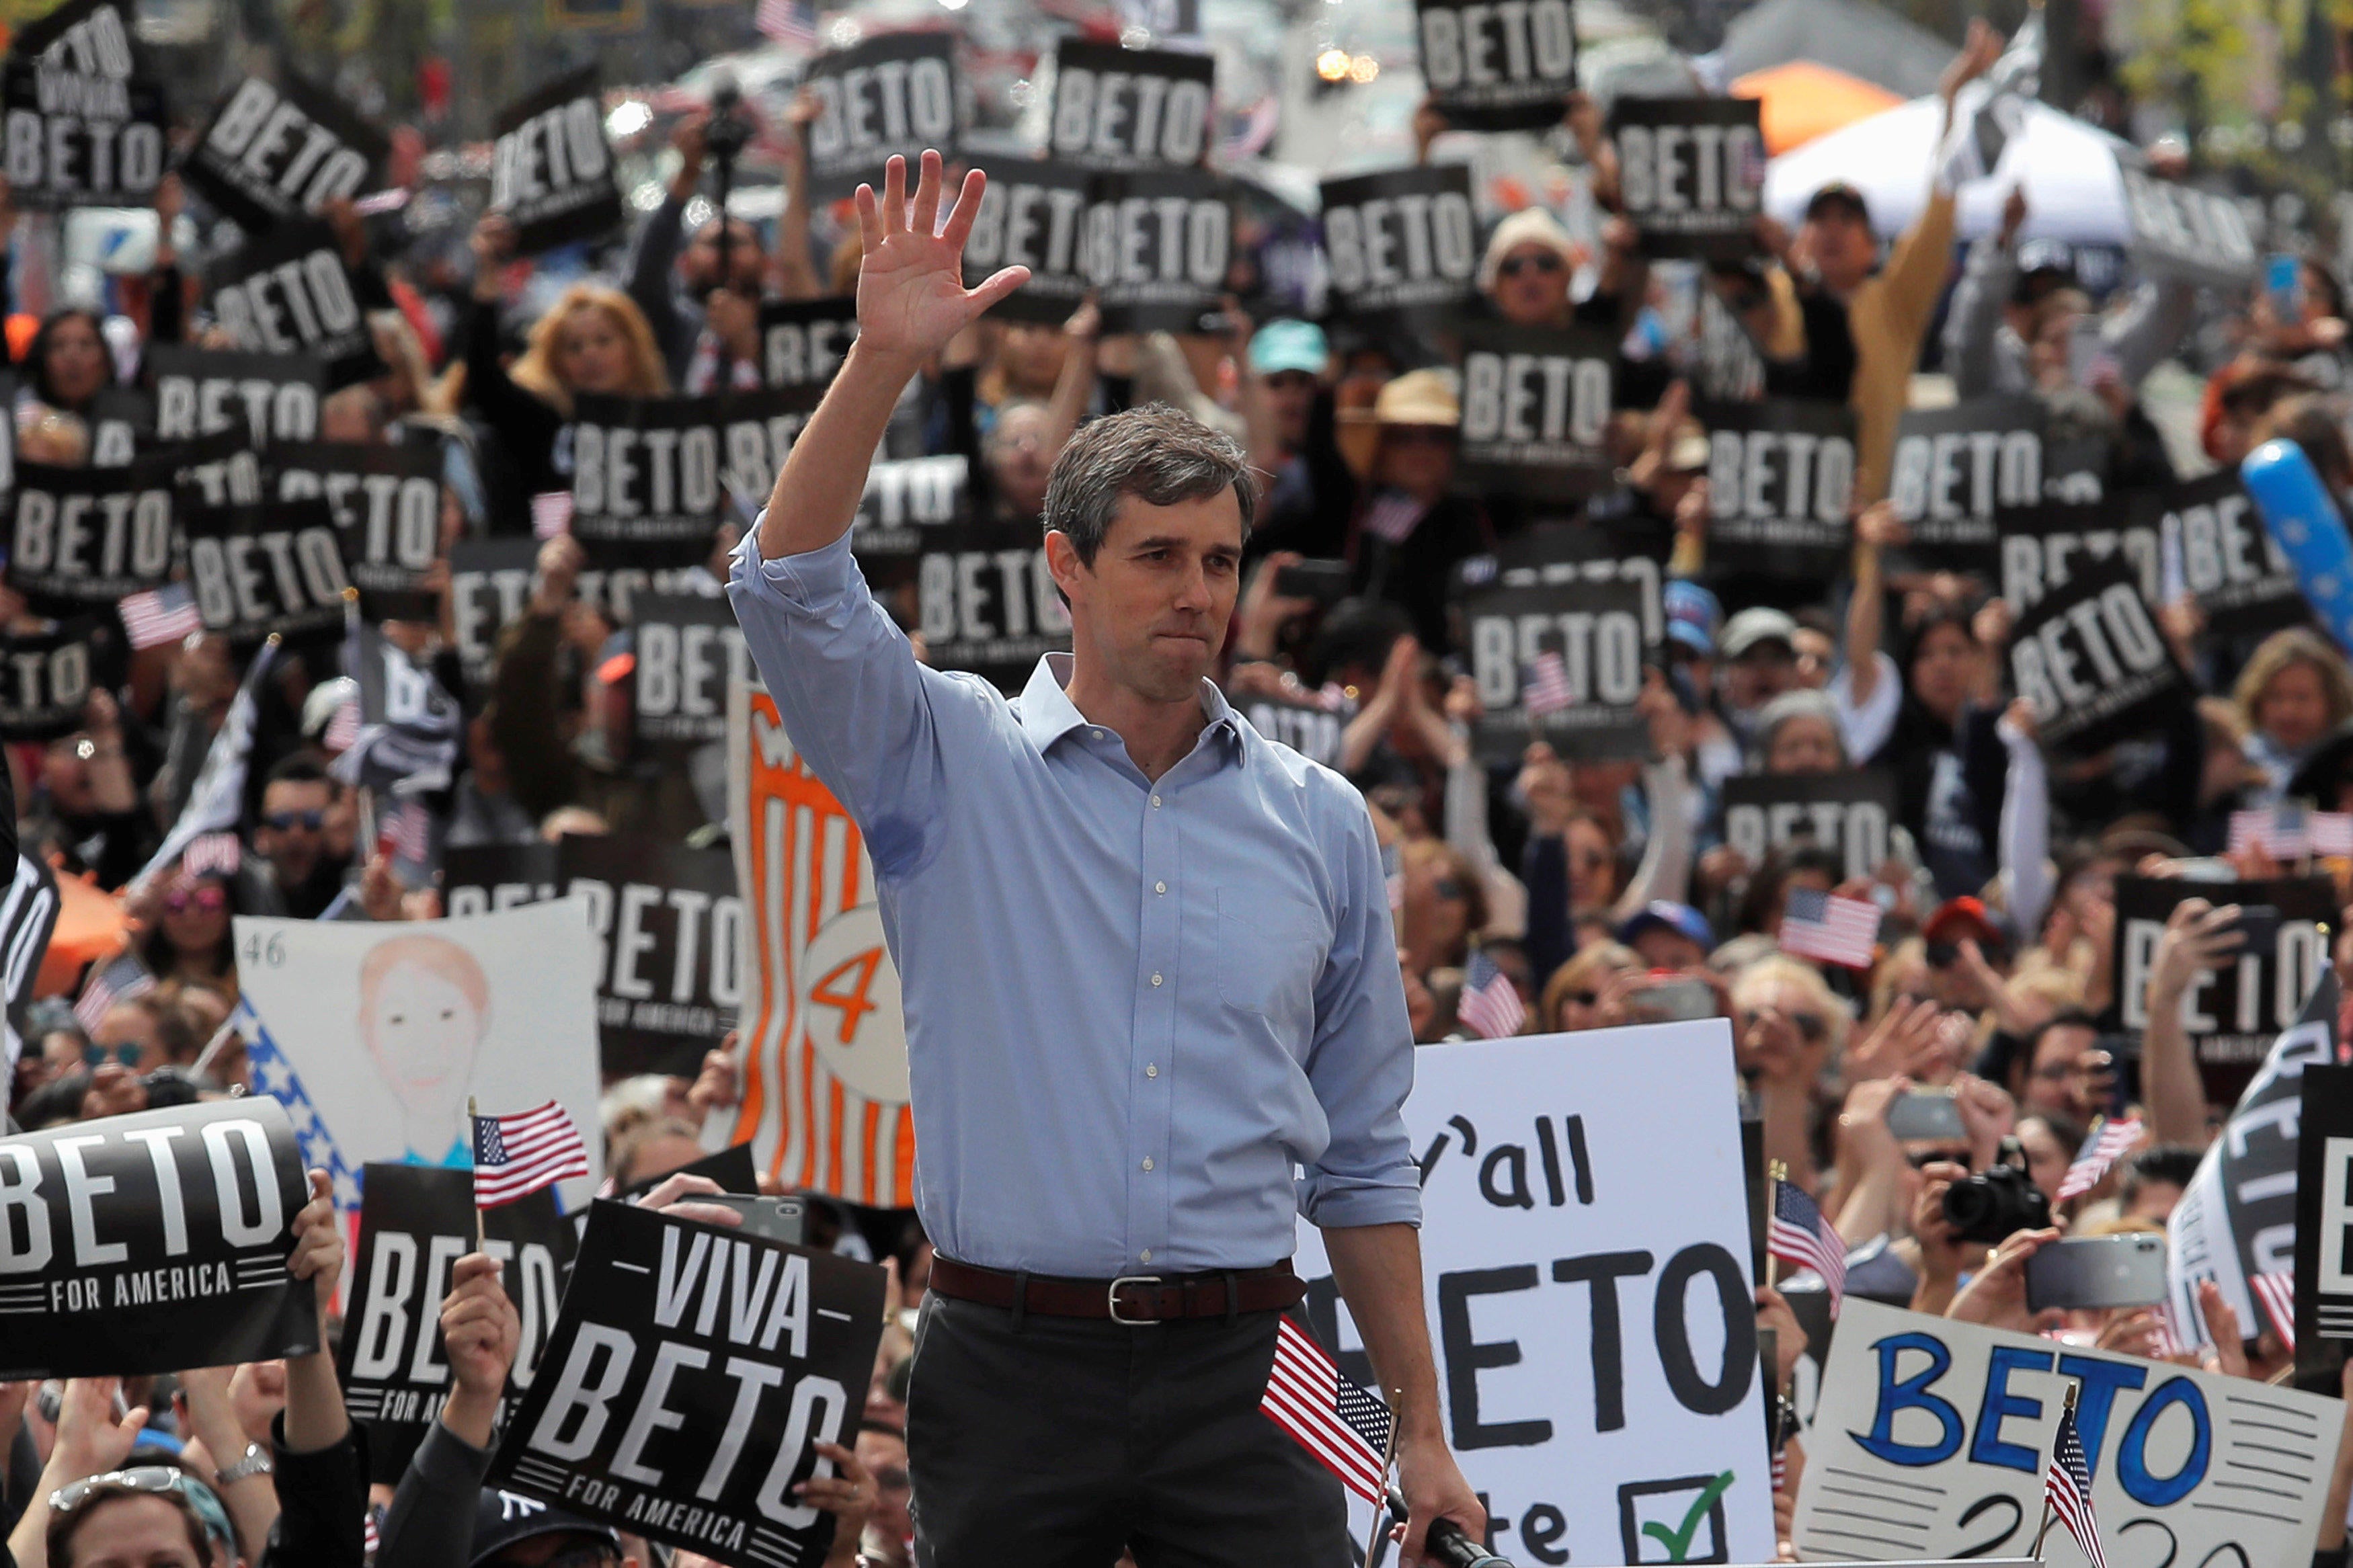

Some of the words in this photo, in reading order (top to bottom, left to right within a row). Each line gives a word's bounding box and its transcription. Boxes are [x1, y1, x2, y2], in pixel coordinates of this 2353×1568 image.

[1421, 0, 1574, 89] BETO
[7, 108, 161, 194] BETO
[207, 77, 369, 215] BETO
[489, 96, 606, 214] BETO
[811, 57, 954, 159] BETO
[1053, 67, 1210, 167] BETO
[1618, 124, 1760, 213] BETO
[964, 179, 1086, 274] BET
[1079, 196, 1230, 288] BETO
[1324, 191, 1476, 294] BETO
[1462, 352, 1611, 446] BETO
[572, 421, 719, 518] BETO
[1709, 429, 1856, 526] BETO
[1889, 430, 2042, 522] BETO
[11, 489, 173, 578] BETO
[191, 526, 350, 628] BETO
[636, 622, 752, 716] BET
[2011, 582, 2166, 724] BETO
[243, 932, 286, 968] 46
[810, 946, 886, 1045] 4
[0, 1118, 284, 1274] BETO
[51, 1278, 99, 1313] FOR
[114, 1261, 231, 1307] AMERICA
[652, 1224, 810, 1358] VIVA
[380, 1388, 418, 1422] FOR
[529, 1320, 848, 1531] BETO
[1847, 1331, 2212, 1508] BETO
[565, 1474, 618, 1514] FOR
[625, 1495, 747, 1553] AMERICA
